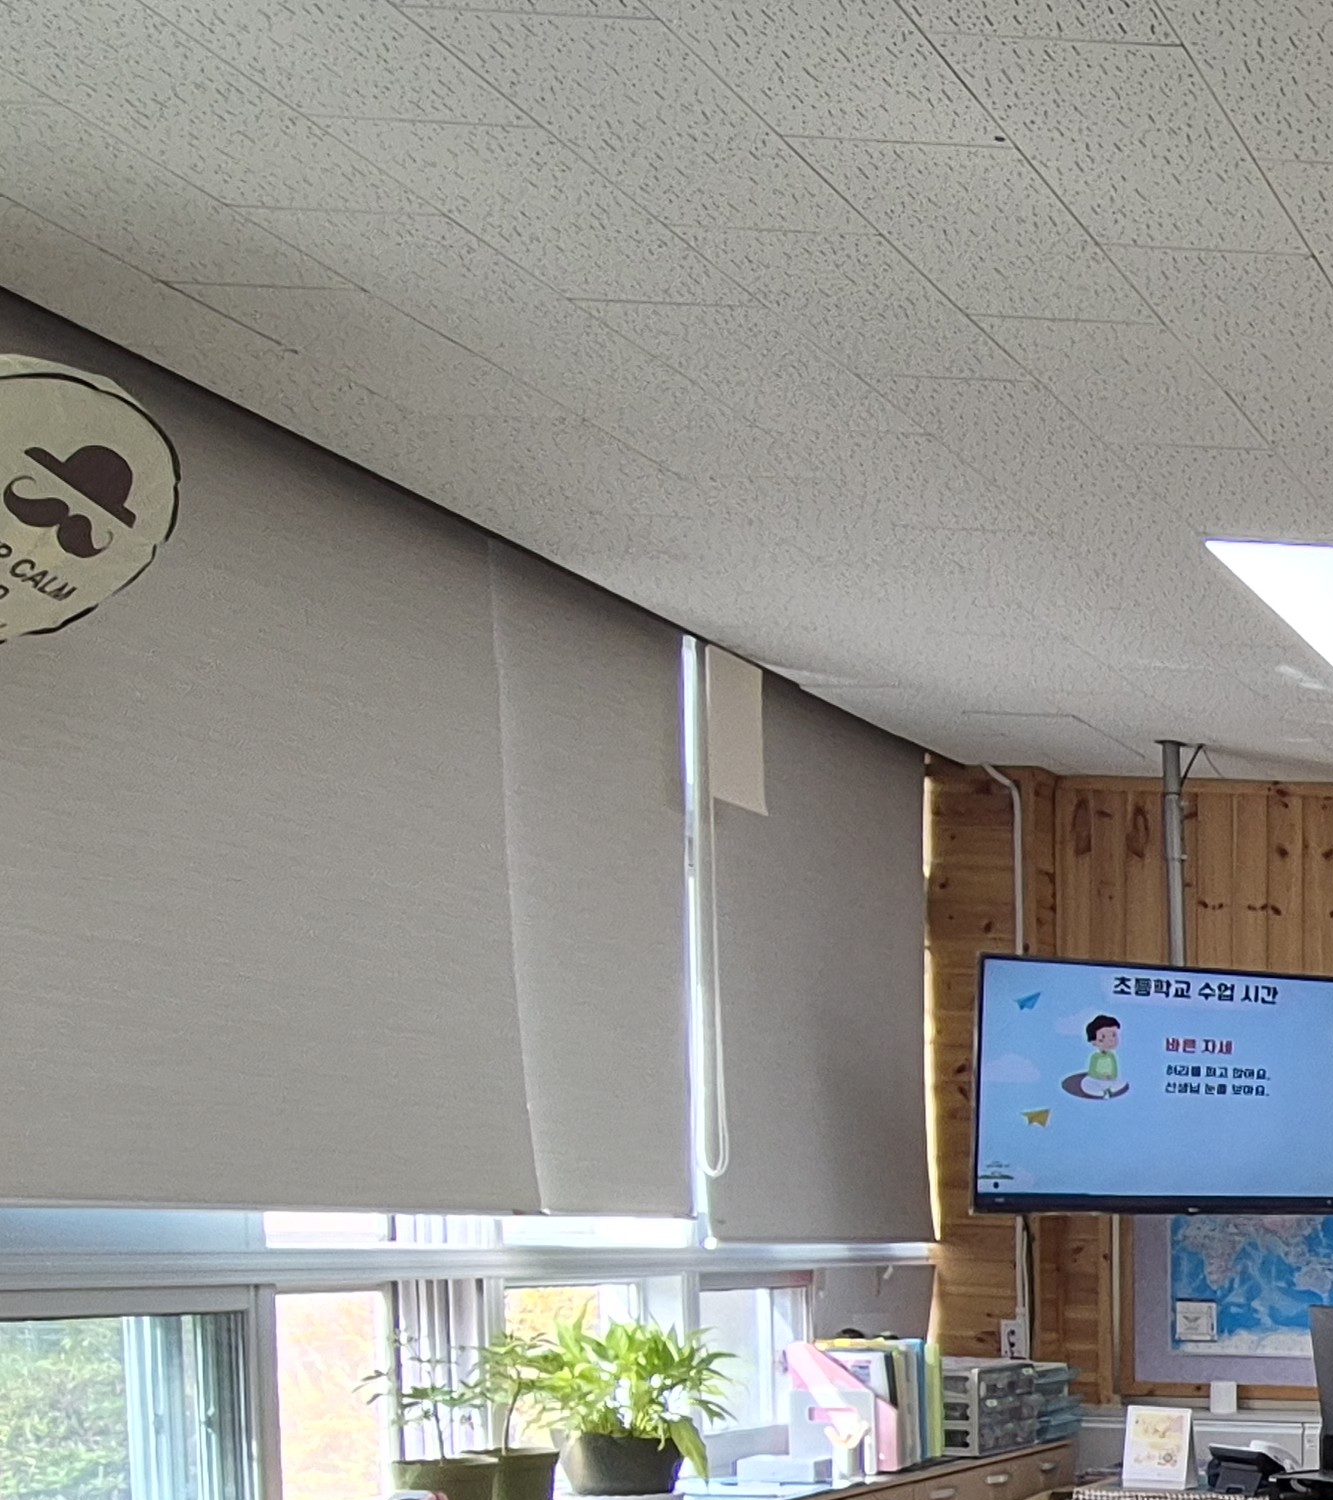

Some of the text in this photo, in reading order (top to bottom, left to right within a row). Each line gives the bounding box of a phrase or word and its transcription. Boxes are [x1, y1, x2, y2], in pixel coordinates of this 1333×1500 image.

[9, 559, 78, 601] CALM
[1113, 976, 1279, 1005] 초등학교 수업 시간
[1166, 1038, 1233, 1055] 바른 자세
